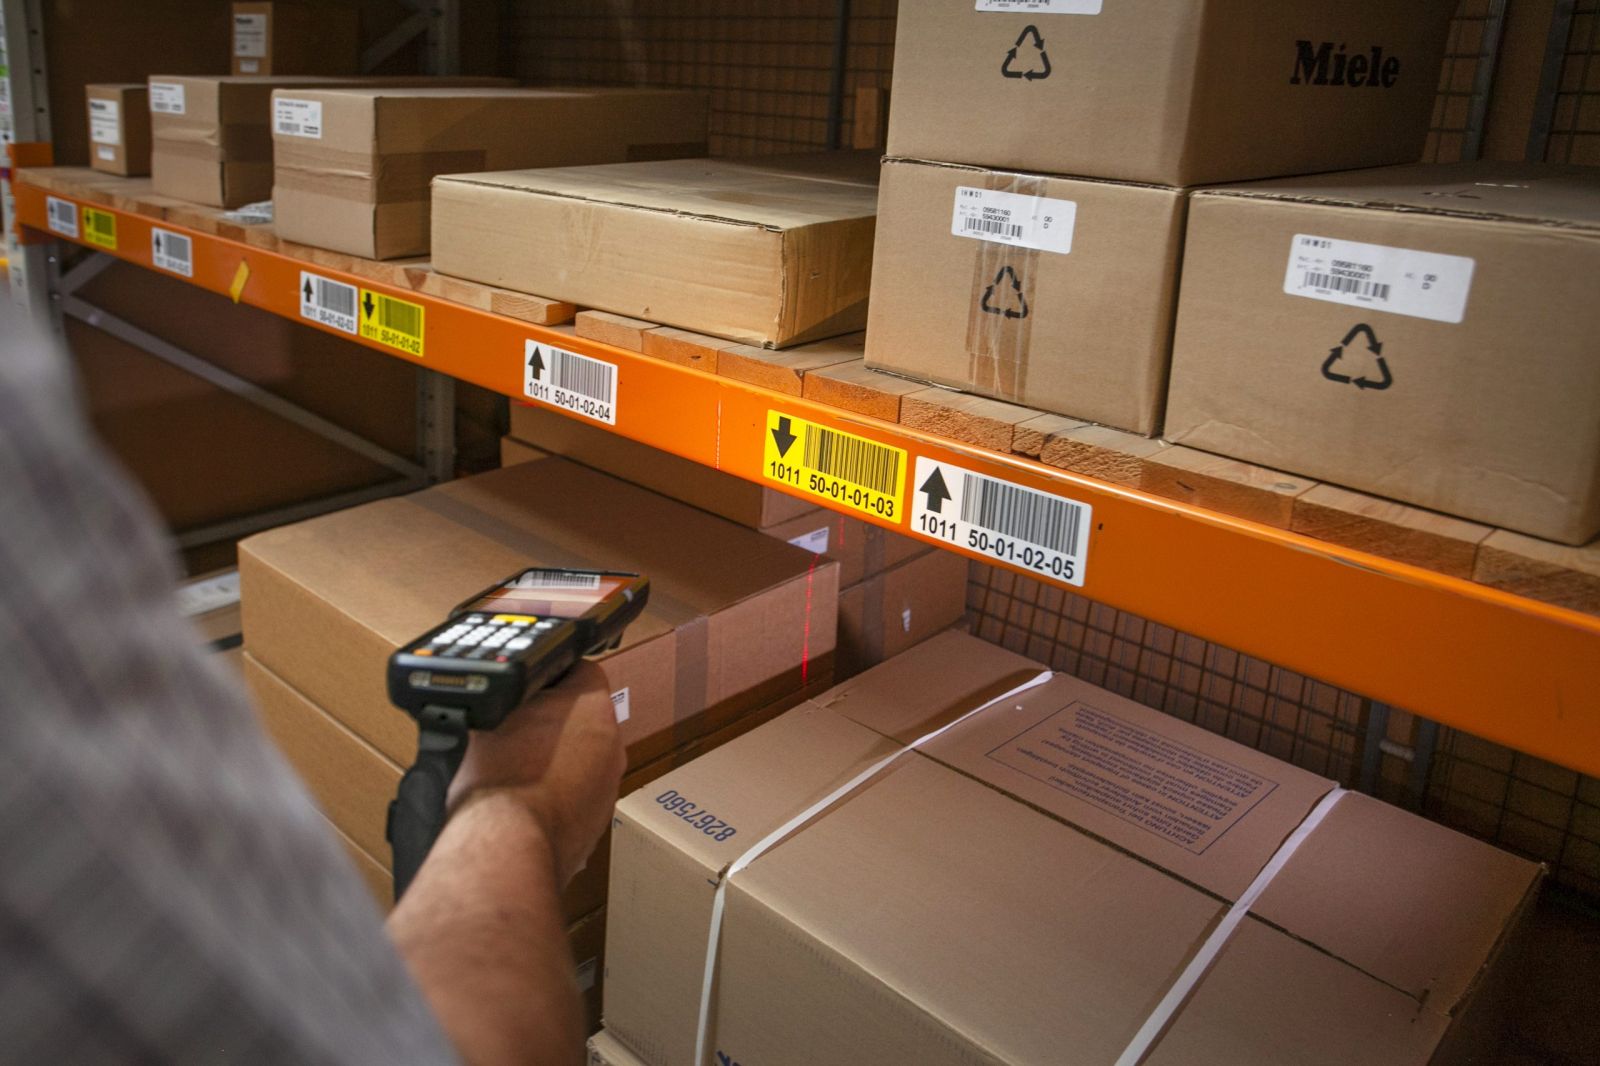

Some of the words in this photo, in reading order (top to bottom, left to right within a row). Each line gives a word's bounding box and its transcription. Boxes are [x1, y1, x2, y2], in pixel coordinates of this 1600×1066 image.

[1290, 40, 1400, 88] Miele
[527, 380, 550, 399] 1011
[554, 388, 611, 422] 50-01-02-04
[769, 460, 801, 486] 1011
[809, 473, 896, 519] 50-01-01-03
[918, 513, 957, 541] 1011
[967, 528, 1075, 581] 50-01-02-05
[656, 790, 737, 842] 8267560
